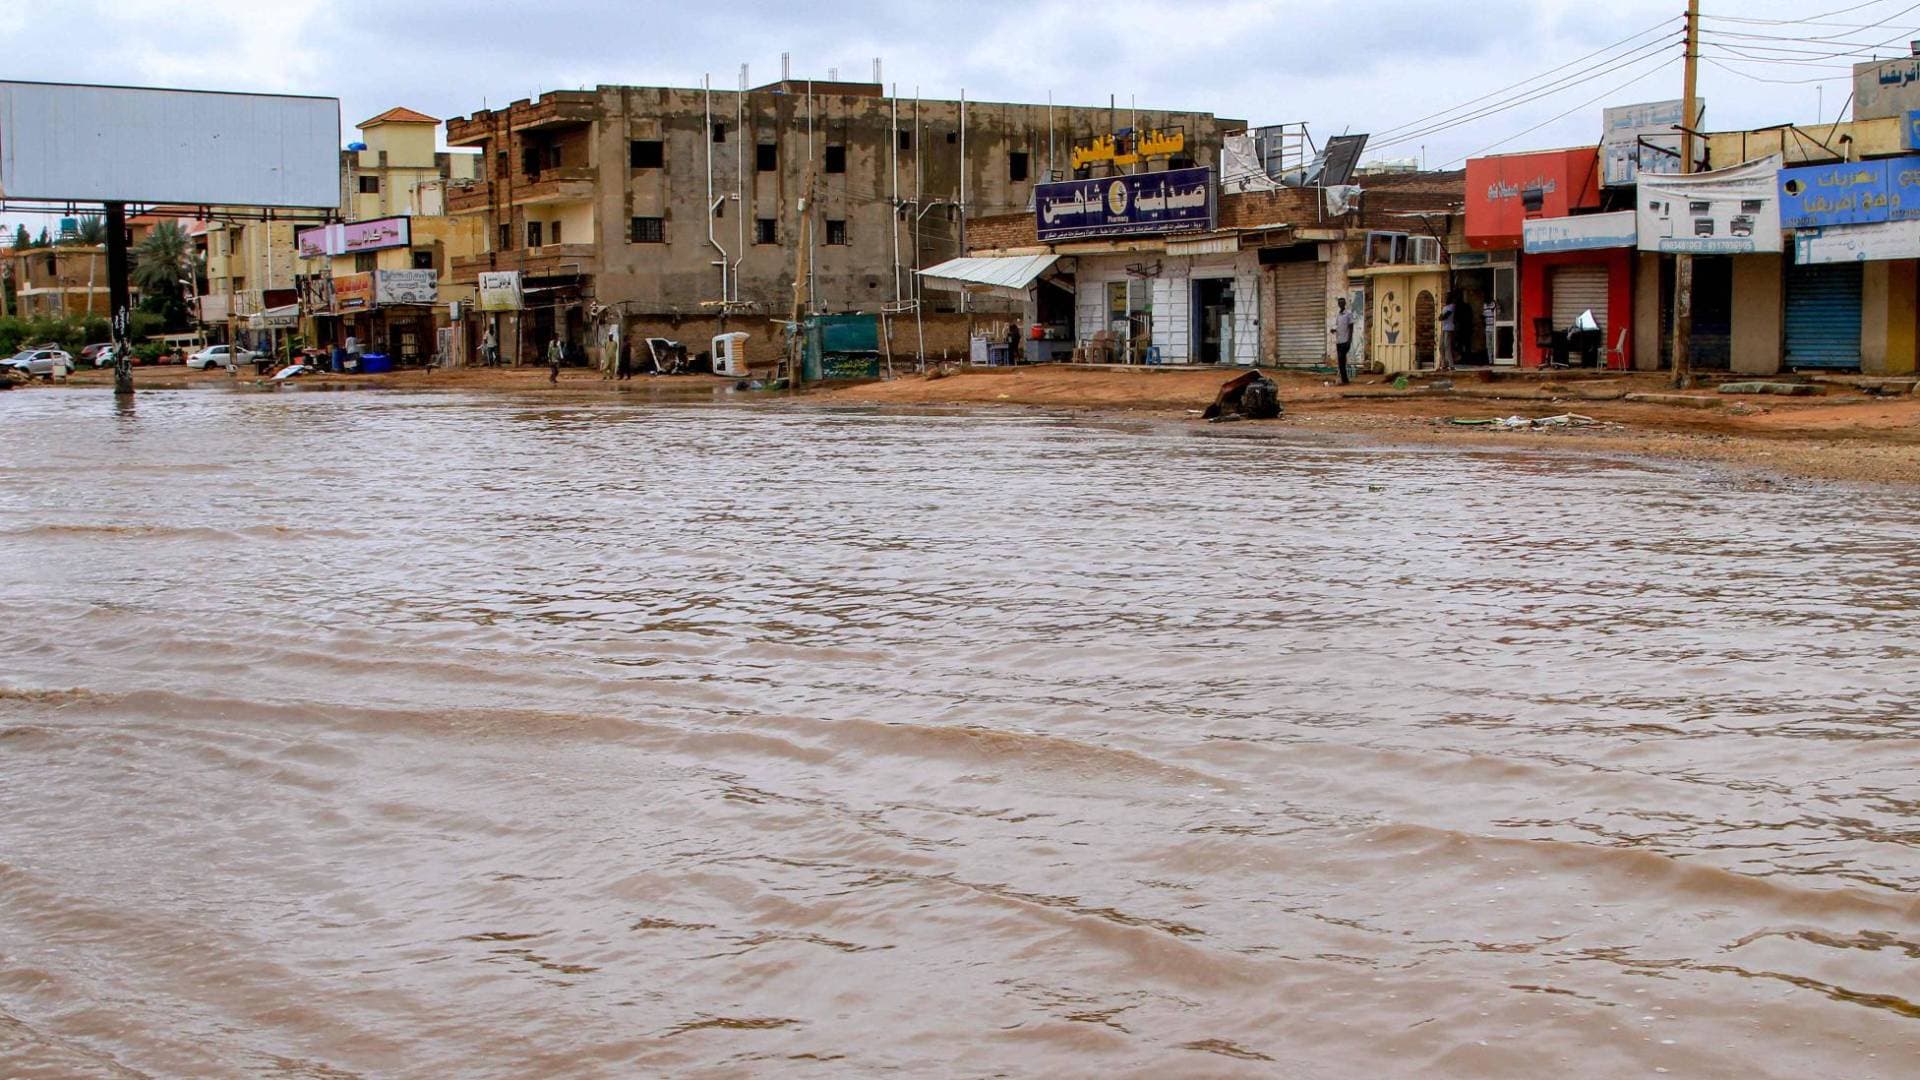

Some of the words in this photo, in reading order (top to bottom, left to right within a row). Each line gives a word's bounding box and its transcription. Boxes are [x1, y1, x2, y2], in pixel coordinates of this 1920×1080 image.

[1043, 183, 1103, 224] شاهين
[1134, 180, 1206, 218] صيدلية
[1107, 215, 1129, 223] Pharmacy
